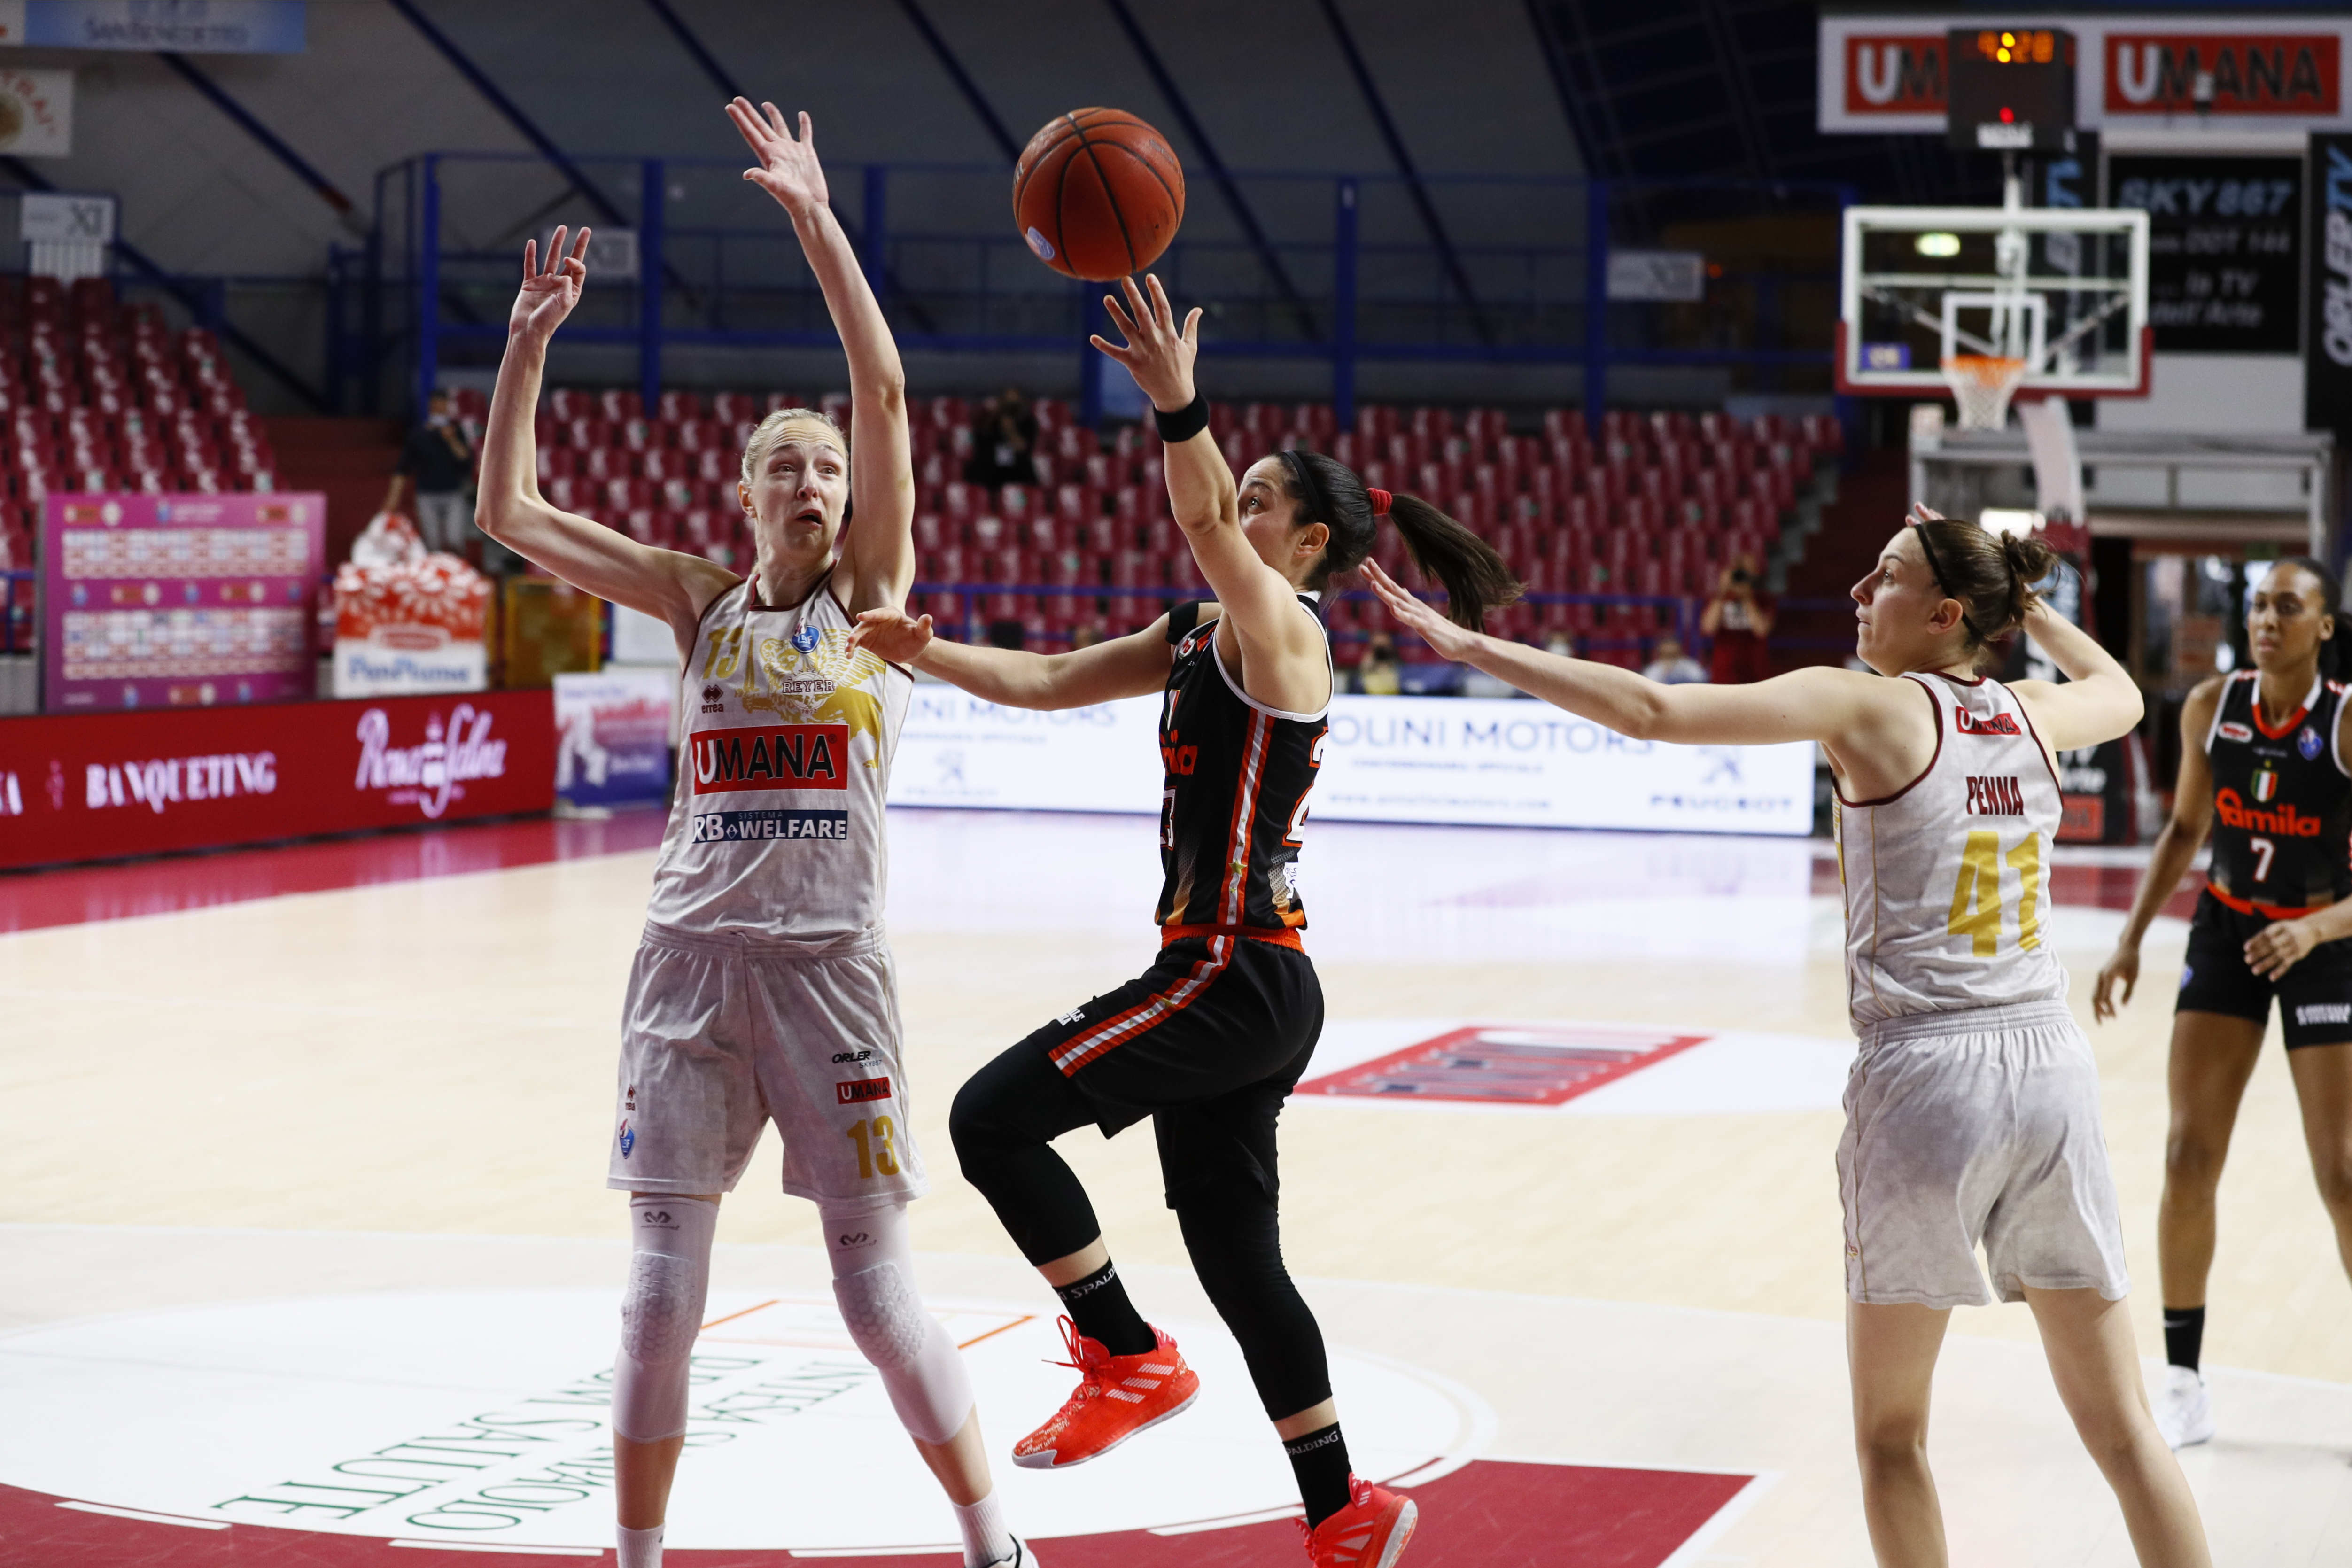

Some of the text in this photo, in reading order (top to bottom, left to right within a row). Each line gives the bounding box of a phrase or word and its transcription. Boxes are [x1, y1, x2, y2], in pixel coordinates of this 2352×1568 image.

[2117, 43, 2323, 105] UMANA
[702, 626, 743, 680] 13
[782, 680, 836, 694] REYER
[696, 734, 837, 785] UMANA
[738, 811, 784, 820] SISTEMA
[1966, 776, 2024, 816] PENNA
[738, 819, 846, 839] WELFARE
[2250, 836, 2275, 883] 7
[1947, 831, 2041, 957] 41
[832, 1050, 871, 1064] ORLER
[841, 1080, 889, 1100] UMANA
[846, 1115, 900, 1180] 13
[1071, 1266, 1116, 1299] SPALD
[211, 1412, 601, 1520] SALUTE
